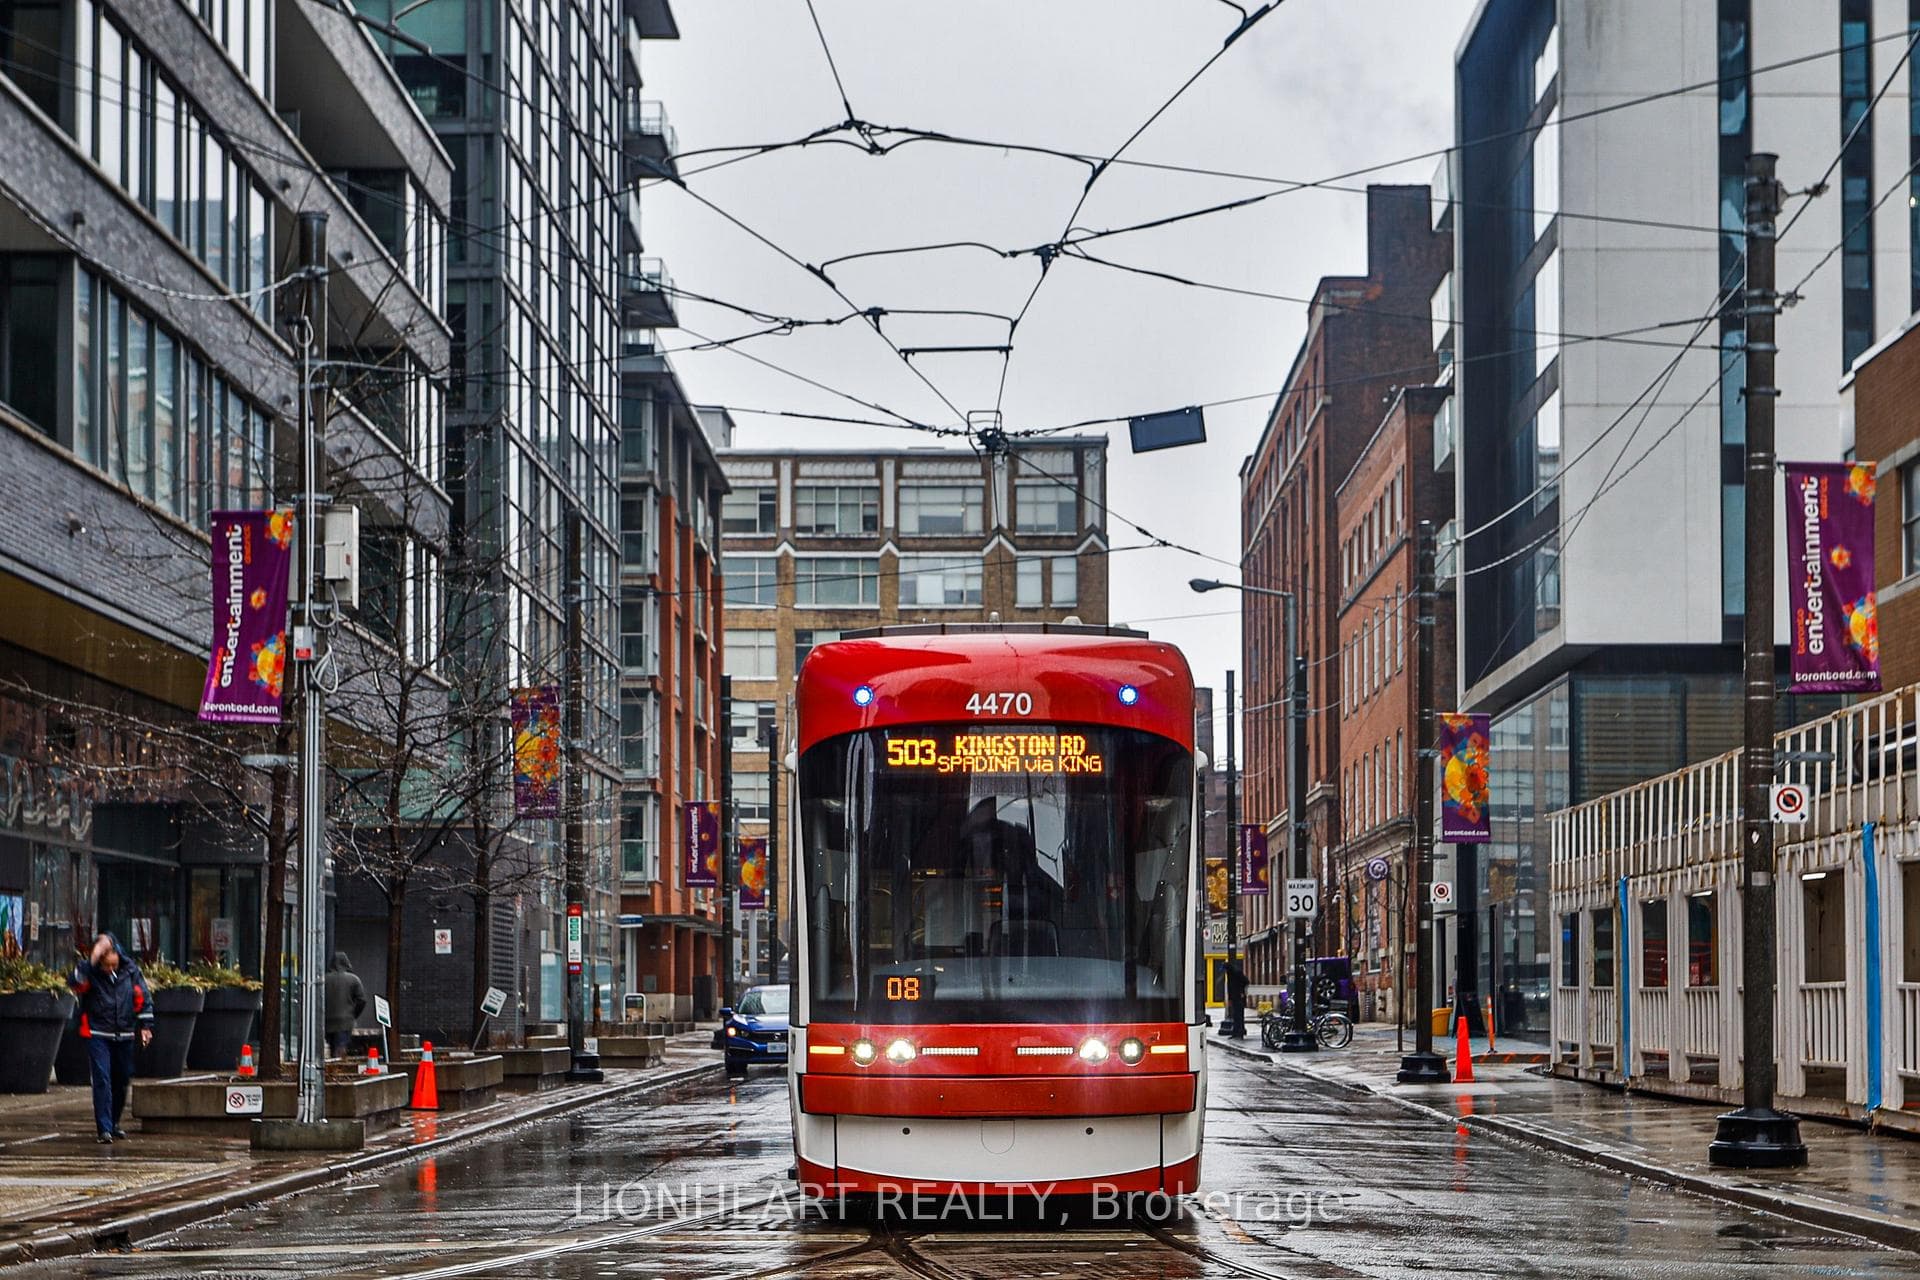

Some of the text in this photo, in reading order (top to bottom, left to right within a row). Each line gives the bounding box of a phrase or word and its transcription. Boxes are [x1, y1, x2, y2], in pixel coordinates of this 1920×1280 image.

[1801, 476, 1824, 654] entertainment
[221, 524, 243, 688] entertainment
[1795, 669, 1876, 682] torontoed.com
[204, 701, 279, 714] torontoed.com
[966, 693, 1032, 715] 4470
[887, 739, 936, 765] 503
[955, 735, 1086, 756] KINGSTON RD
[938, 756, 1102, 772] SPADINA via KING
[1289, 895, 1314, 911] 30
[887, 977, 919, 1000] 08
